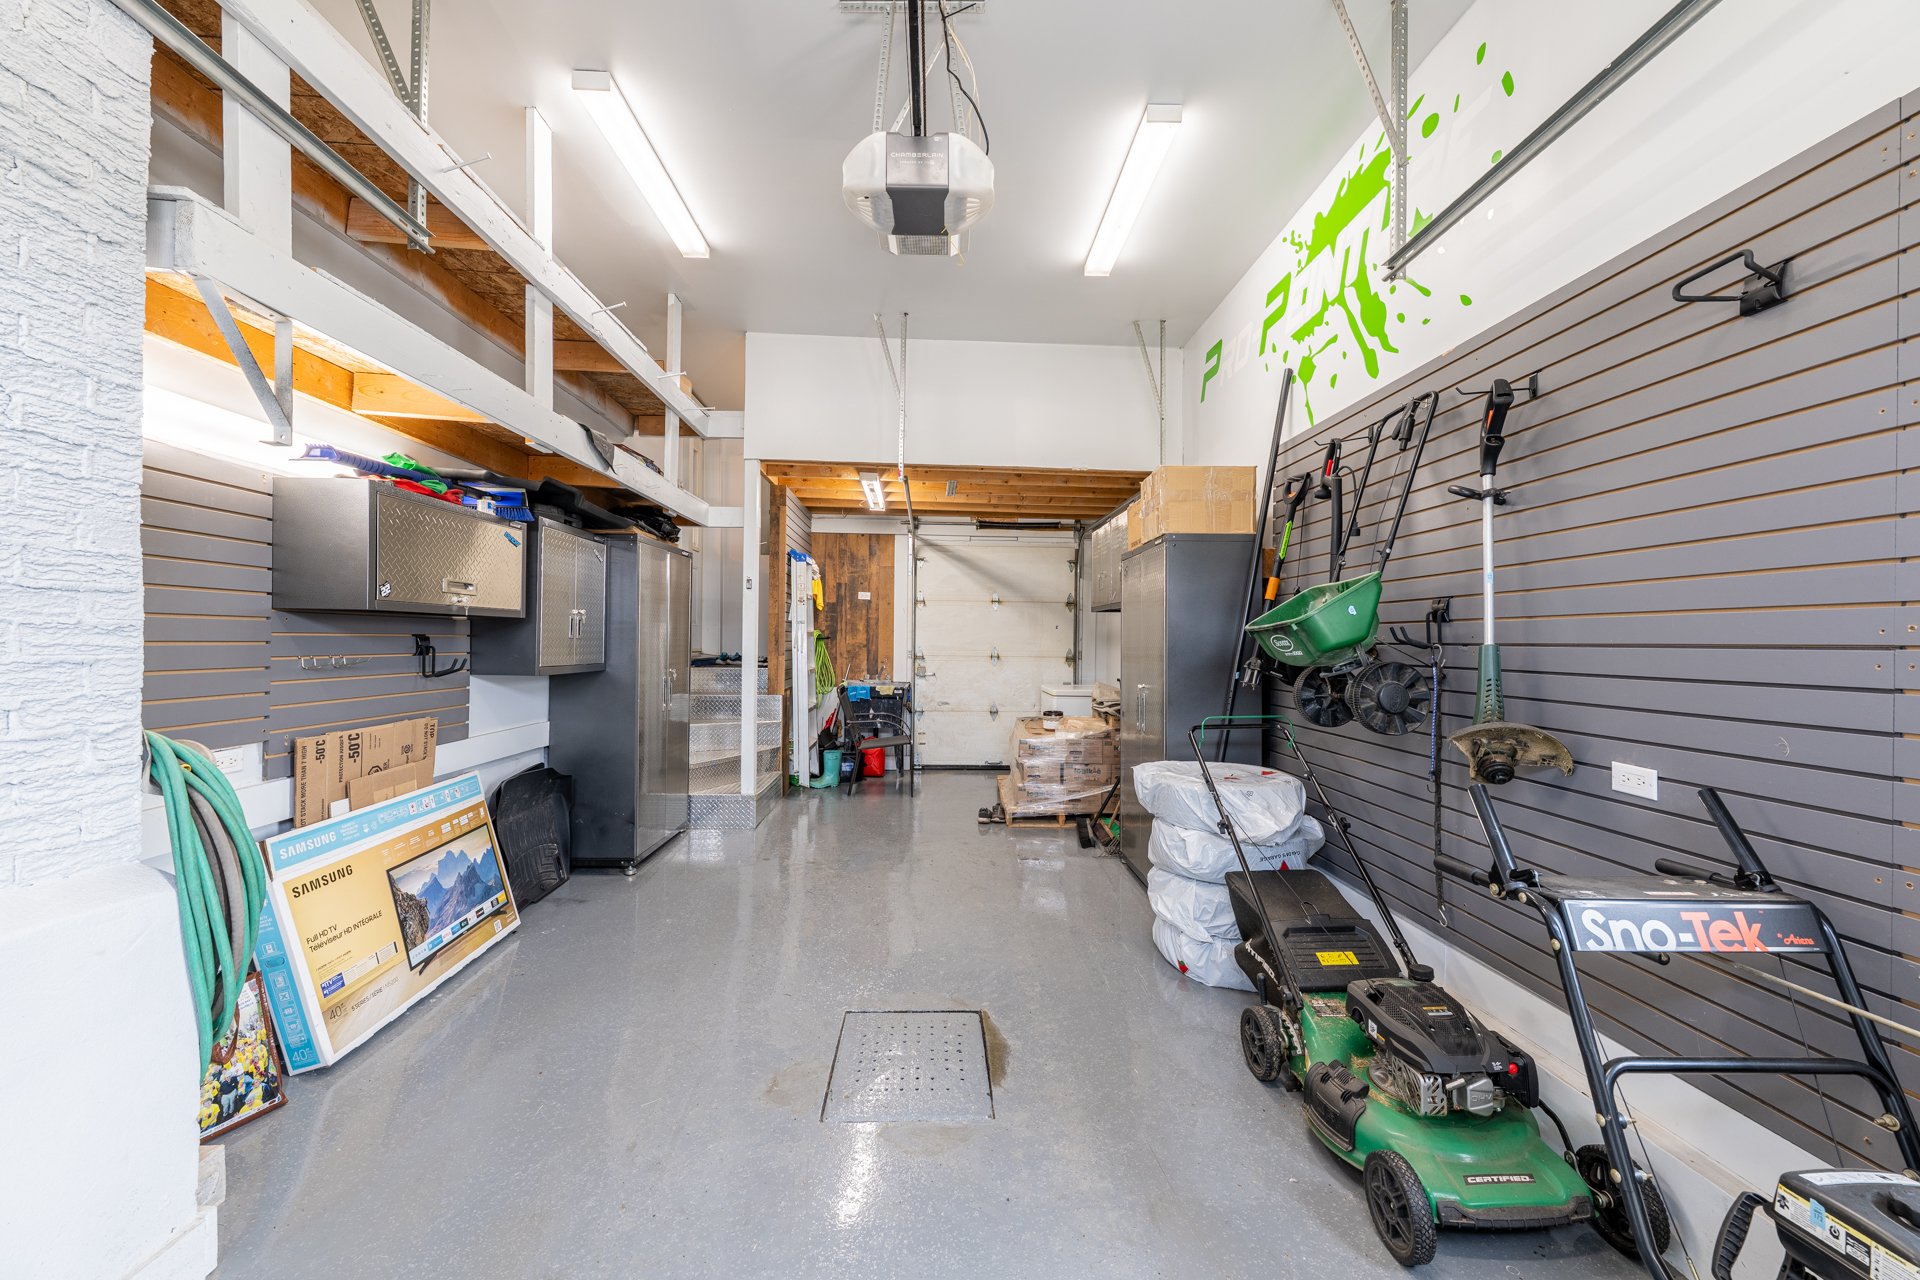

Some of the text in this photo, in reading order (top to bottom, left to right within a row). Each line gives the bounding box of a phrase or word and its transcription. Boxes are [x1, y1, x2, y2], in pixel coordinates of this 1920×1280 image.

[280, 831, 337, 860] SAMSUNG
[291, 864, 353, 898] SAMSUNG
[305, 924, 338, 945] Full HD TV
[343, 926, 353, 936] HD
[1581, 908, 1769, 952] Sno-Tek
[1466, 1175, 1530, 1183] CERTIFIED
